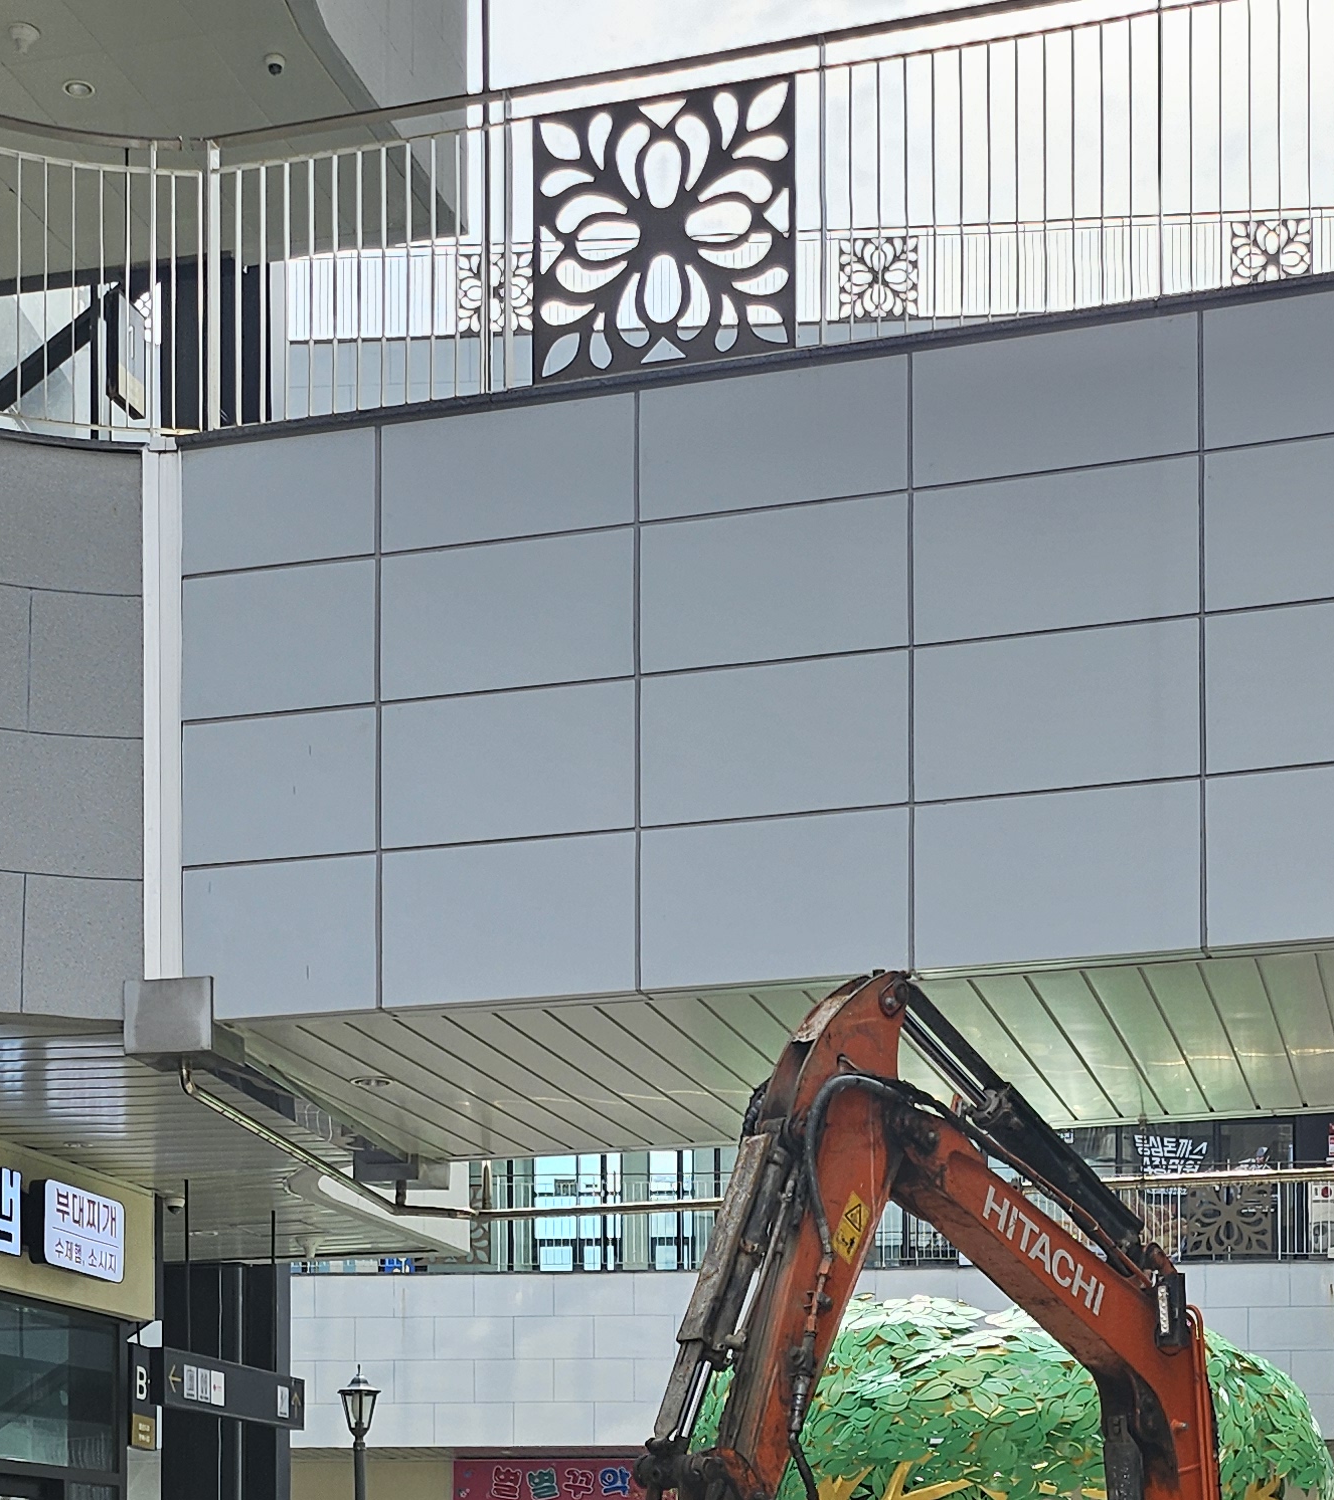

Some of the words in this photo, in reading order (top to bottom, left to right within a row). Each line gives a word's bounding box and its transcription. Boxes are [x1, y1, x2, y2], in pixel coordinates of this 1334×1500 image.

[56, 1188, 117, 1238] 부대찌개
[88, 1248, 117, 1273] 소시지
[983, 1185, 1105, 1316] HITACHI
